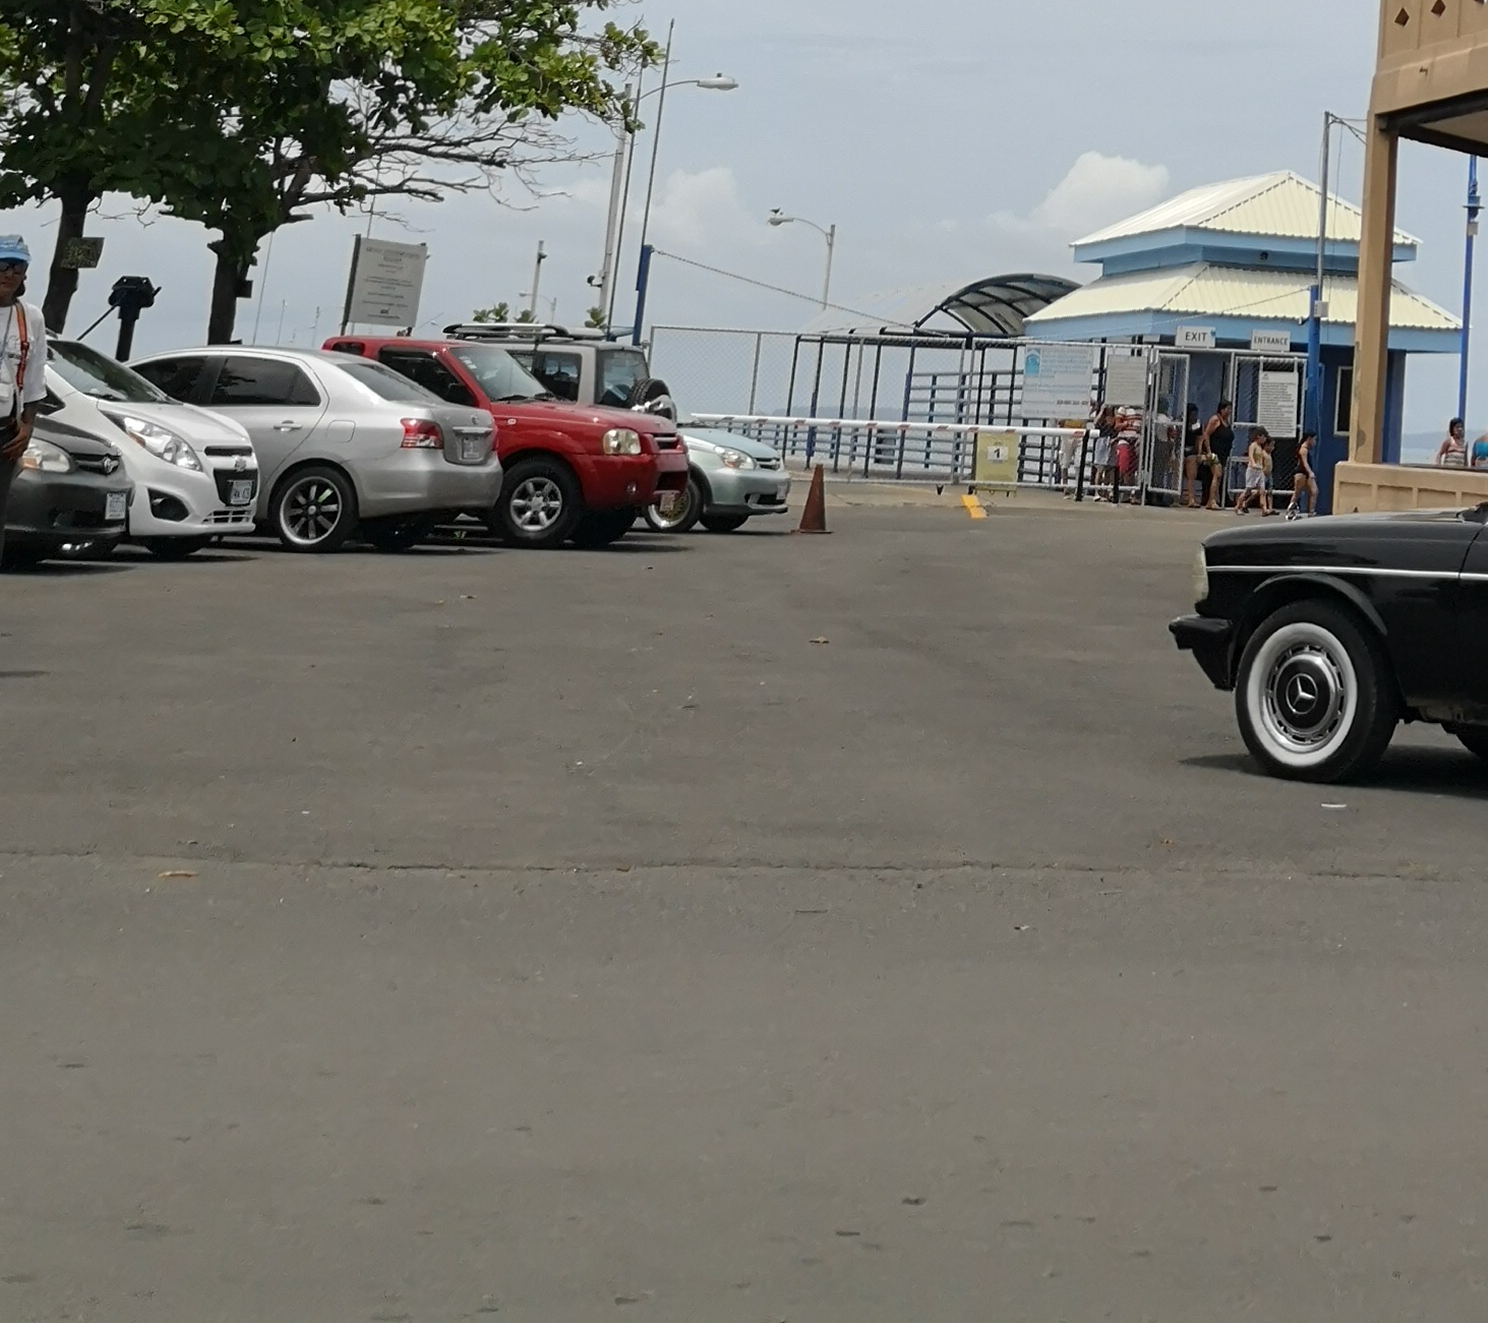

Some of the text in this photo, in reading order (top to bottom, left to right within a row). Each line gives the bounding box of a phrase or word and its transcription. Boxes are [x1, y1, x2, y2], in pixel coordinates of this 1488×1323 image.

[1185, 331, 1208, 342] EXIT
[1254, 336, 1289, 346] ENTRANCE
[994, 448, 1000, 458] 1
